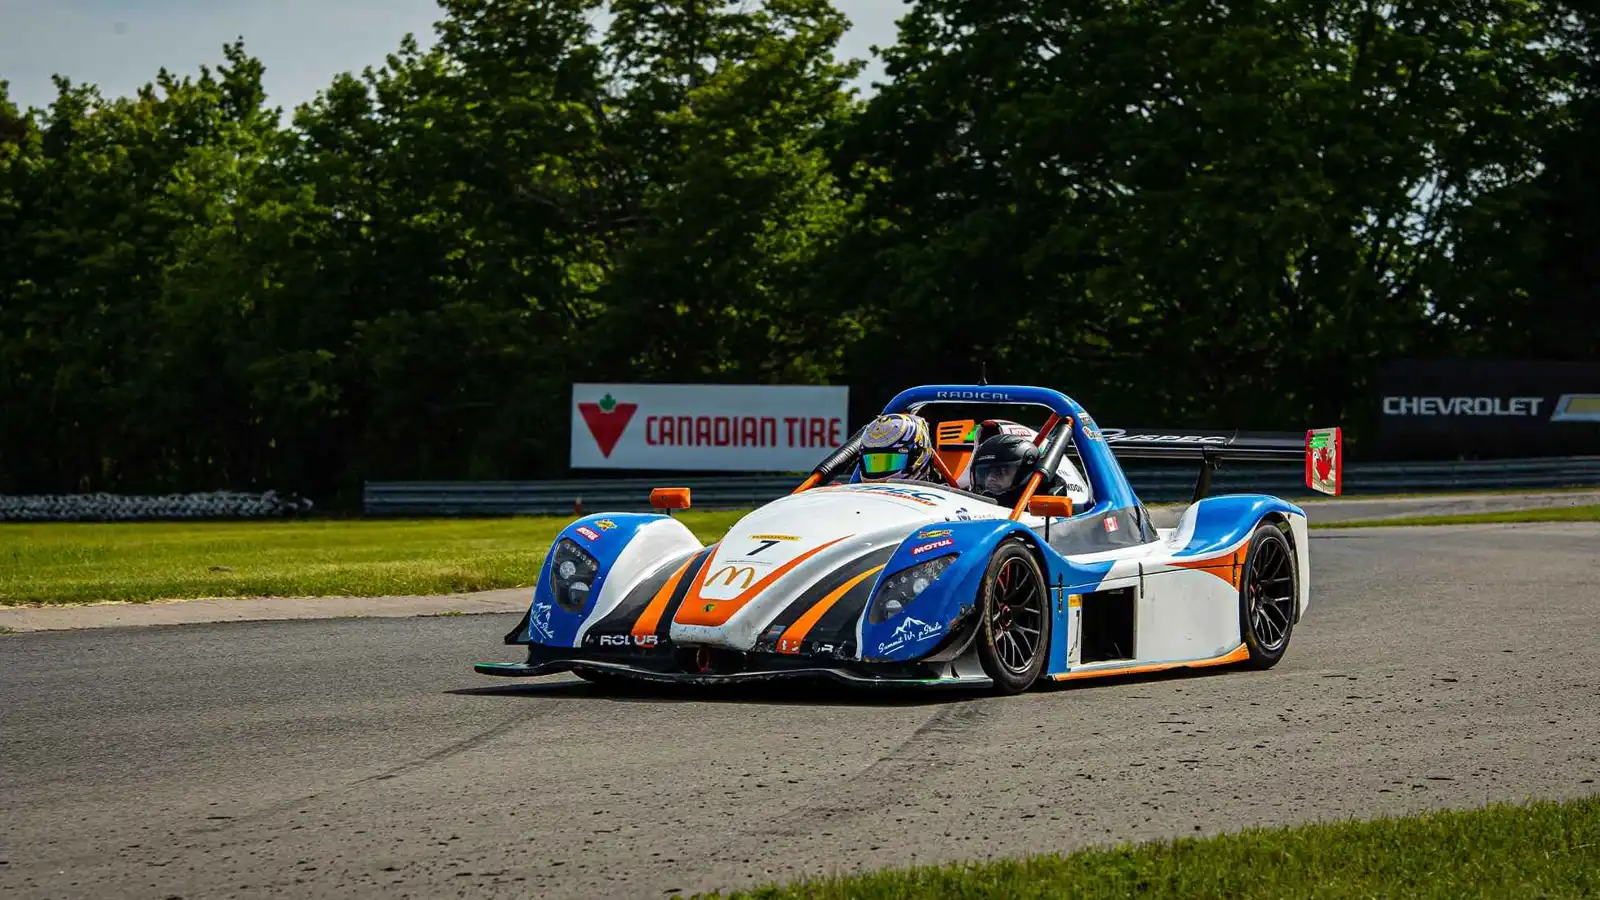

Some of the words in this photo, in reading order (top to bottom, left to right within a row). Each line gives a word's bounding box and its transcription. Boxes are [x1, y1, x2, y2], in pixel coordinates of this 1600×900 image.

[937, 390, 1014, 400] RADICAL
[1382, 396, 1544, 416] CHEVROLET
[645, 415, 776, 447] CANADIAN
[783, 416, 841, 448] TIRE
[746, 540, 780, 556] 7
[913, 539, 952, 555] MOTUL
